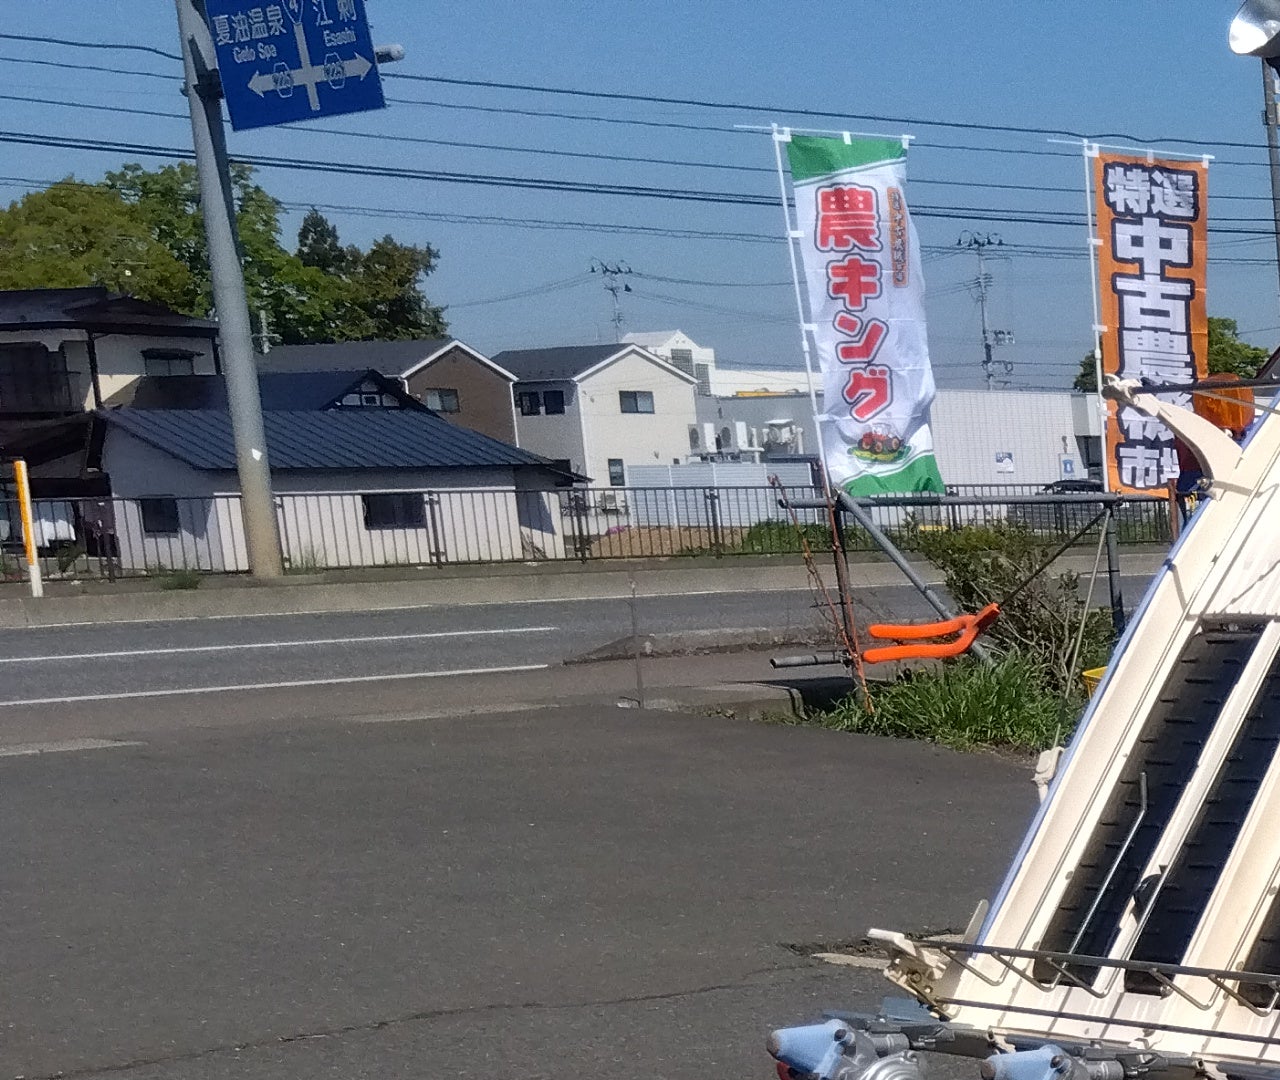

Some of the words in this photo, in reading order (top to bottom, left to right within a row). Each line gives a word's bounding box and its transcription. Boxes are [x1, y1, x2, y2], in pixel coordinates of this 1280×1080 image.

[213, 4, 287, 45] 夏油温泉
[257, 43, 277, 61] Spa
[1107, 166, 1194, 216] 特選
[817, 185, 891, 421] 農キング
